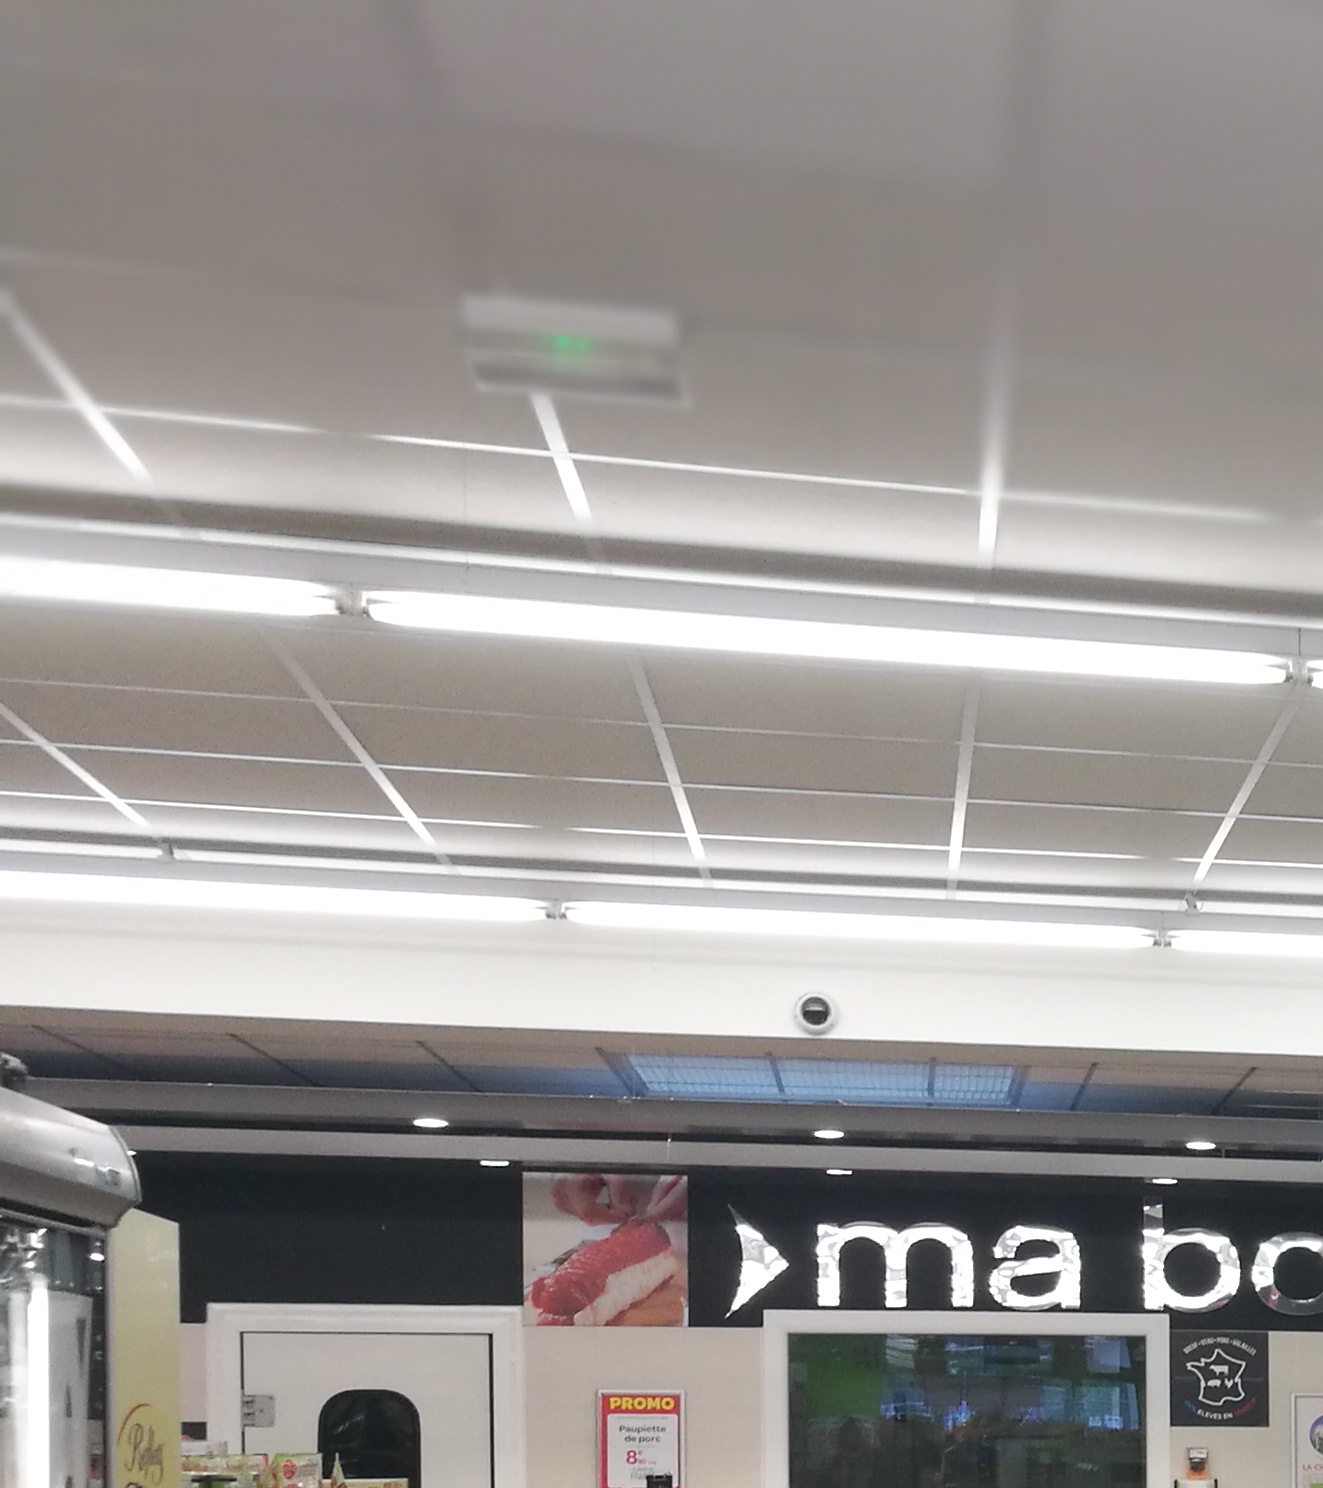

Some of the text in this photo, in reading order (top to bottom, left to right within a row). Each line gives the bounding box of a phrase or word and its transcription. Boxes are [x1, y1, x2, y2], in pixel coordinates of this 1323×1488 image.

[815, 1220, 1082, 1311] ma
[609, 1397, 675, 1411] PROMO
[619, 1424, 666, 1434] Paupiette
[624, 1435, 661, 1444] de porc
